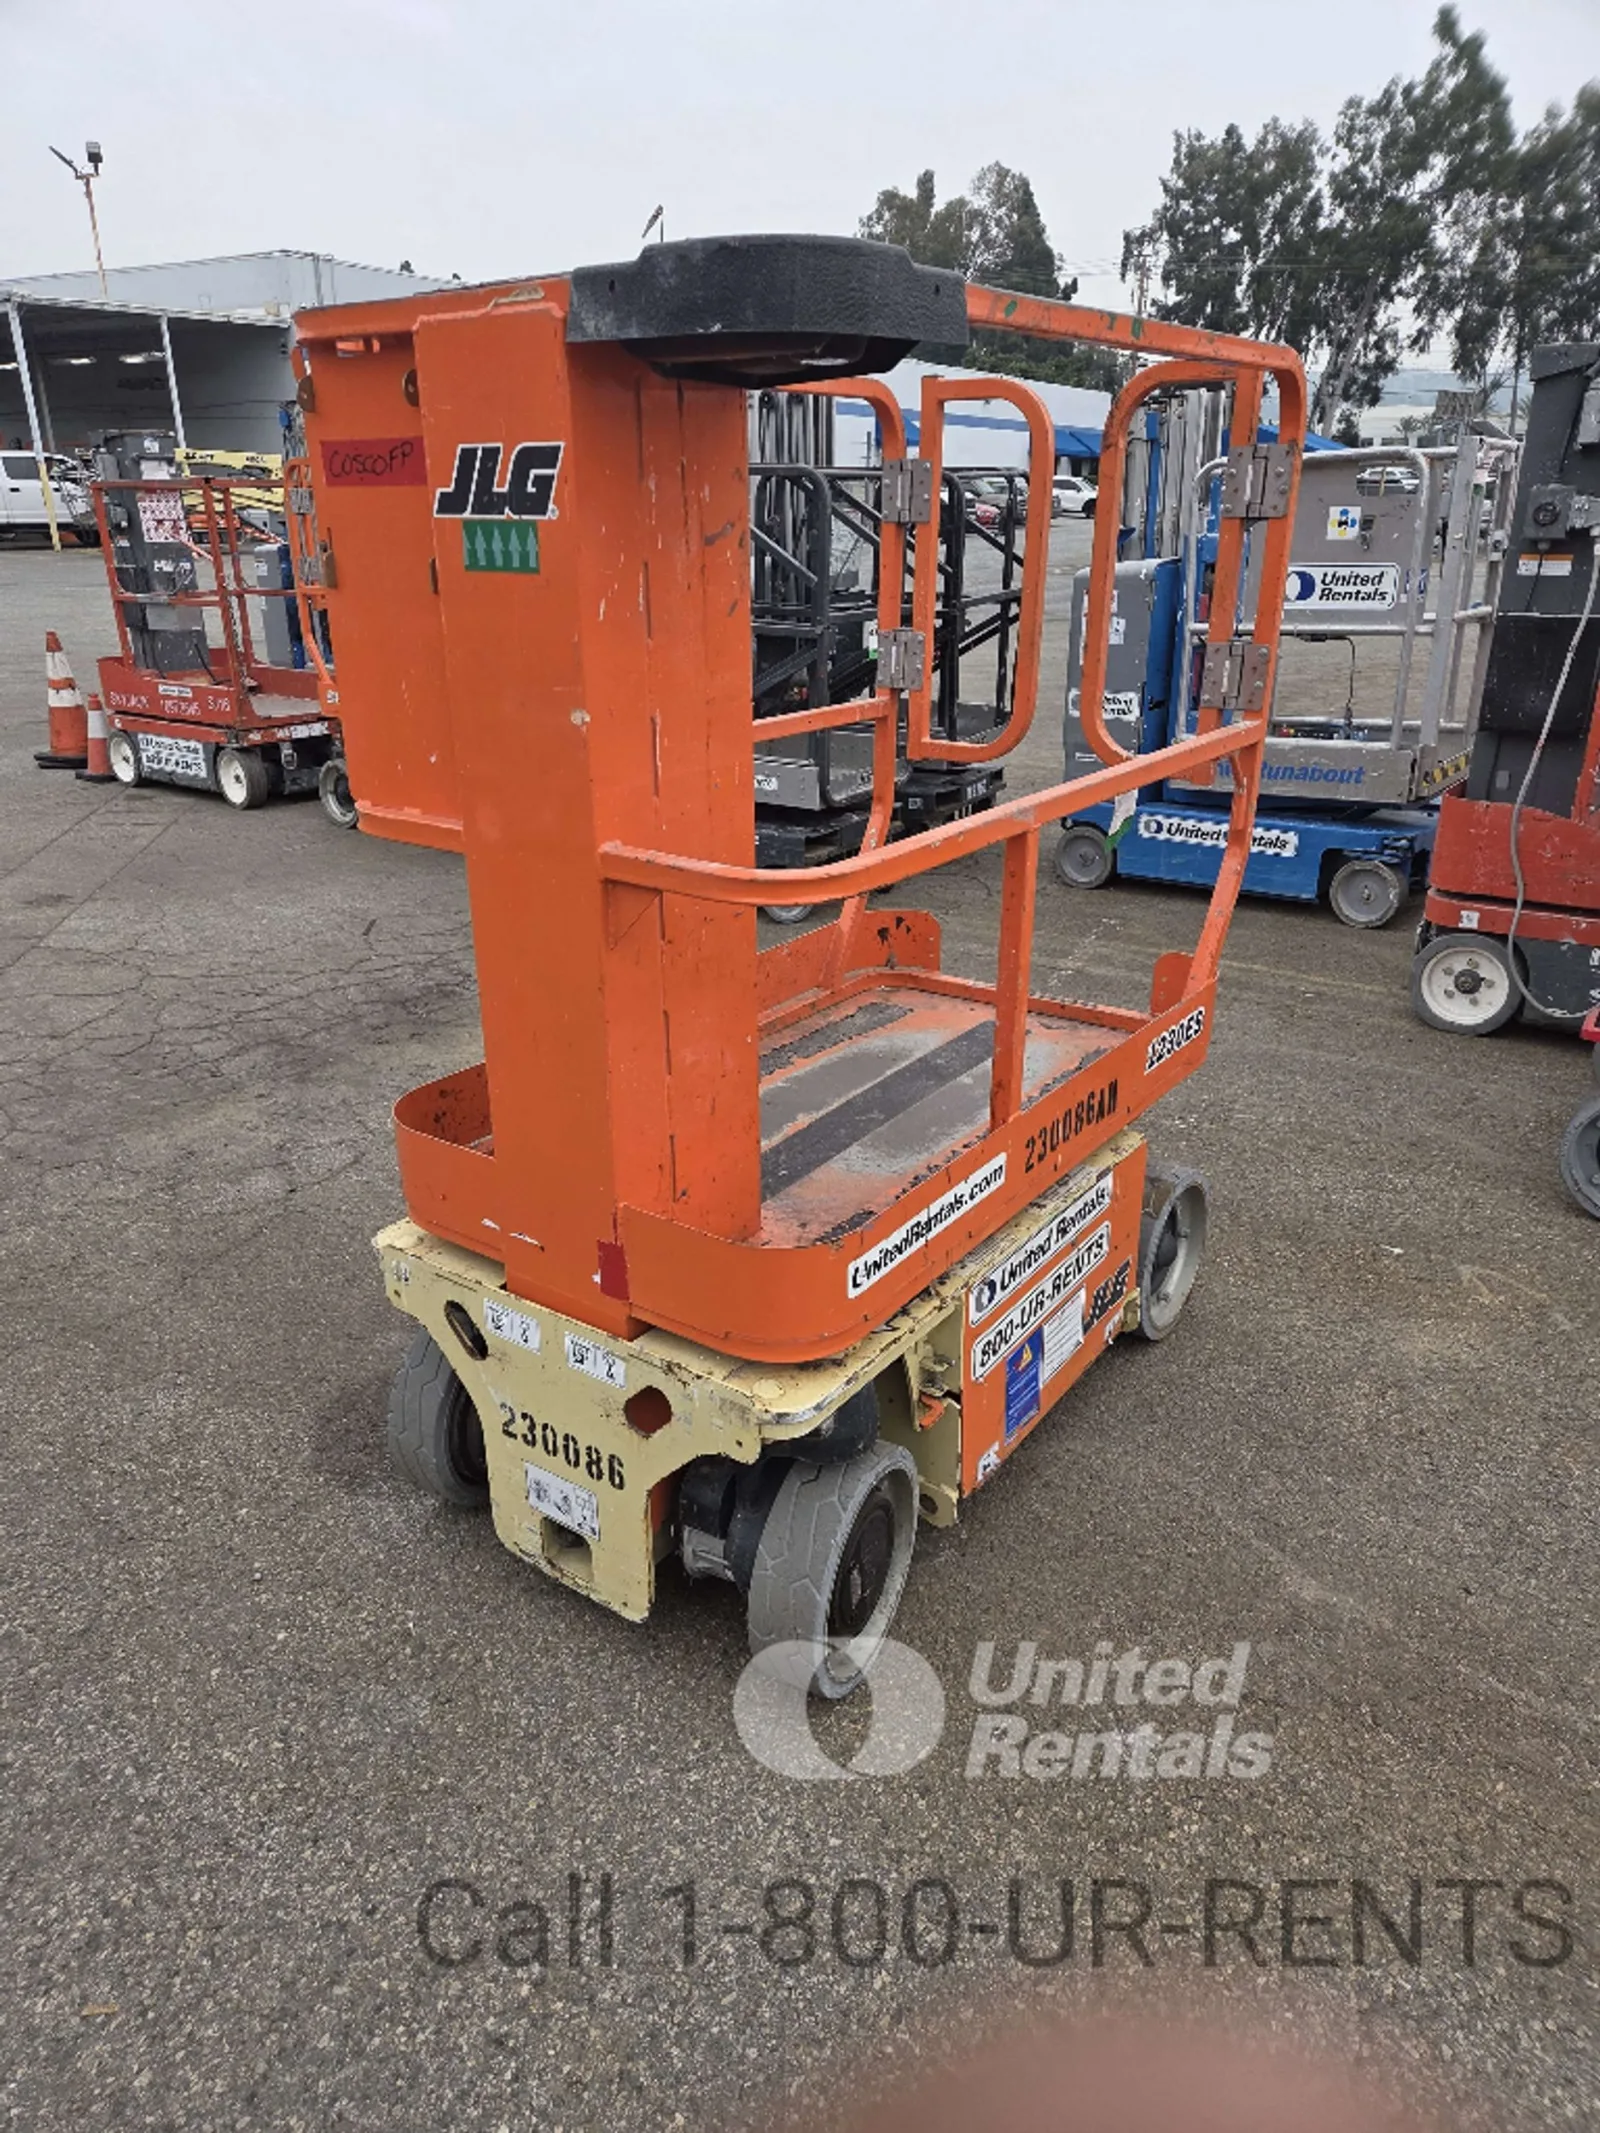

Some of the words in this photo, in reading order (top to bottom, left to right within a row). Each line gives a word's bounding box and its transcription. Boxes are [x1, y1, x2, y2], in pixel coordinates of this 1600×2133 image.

[434, 442, 567, 519] JLG
[1318, 587, 1389, 602] Rentals
[1320, 570, 1385, 587] United
[1166, 822, 1222, 841] United
[1147, 1009, 1204, 1069] 1230ES
[1000, 1228, 1053, 1291] United
[1055, 1186, 1106, 1243] Rentals
[980, 1233, 1105, 1367] 800-UR-RENTS
[500, 1402, 626, 1491] 230086
